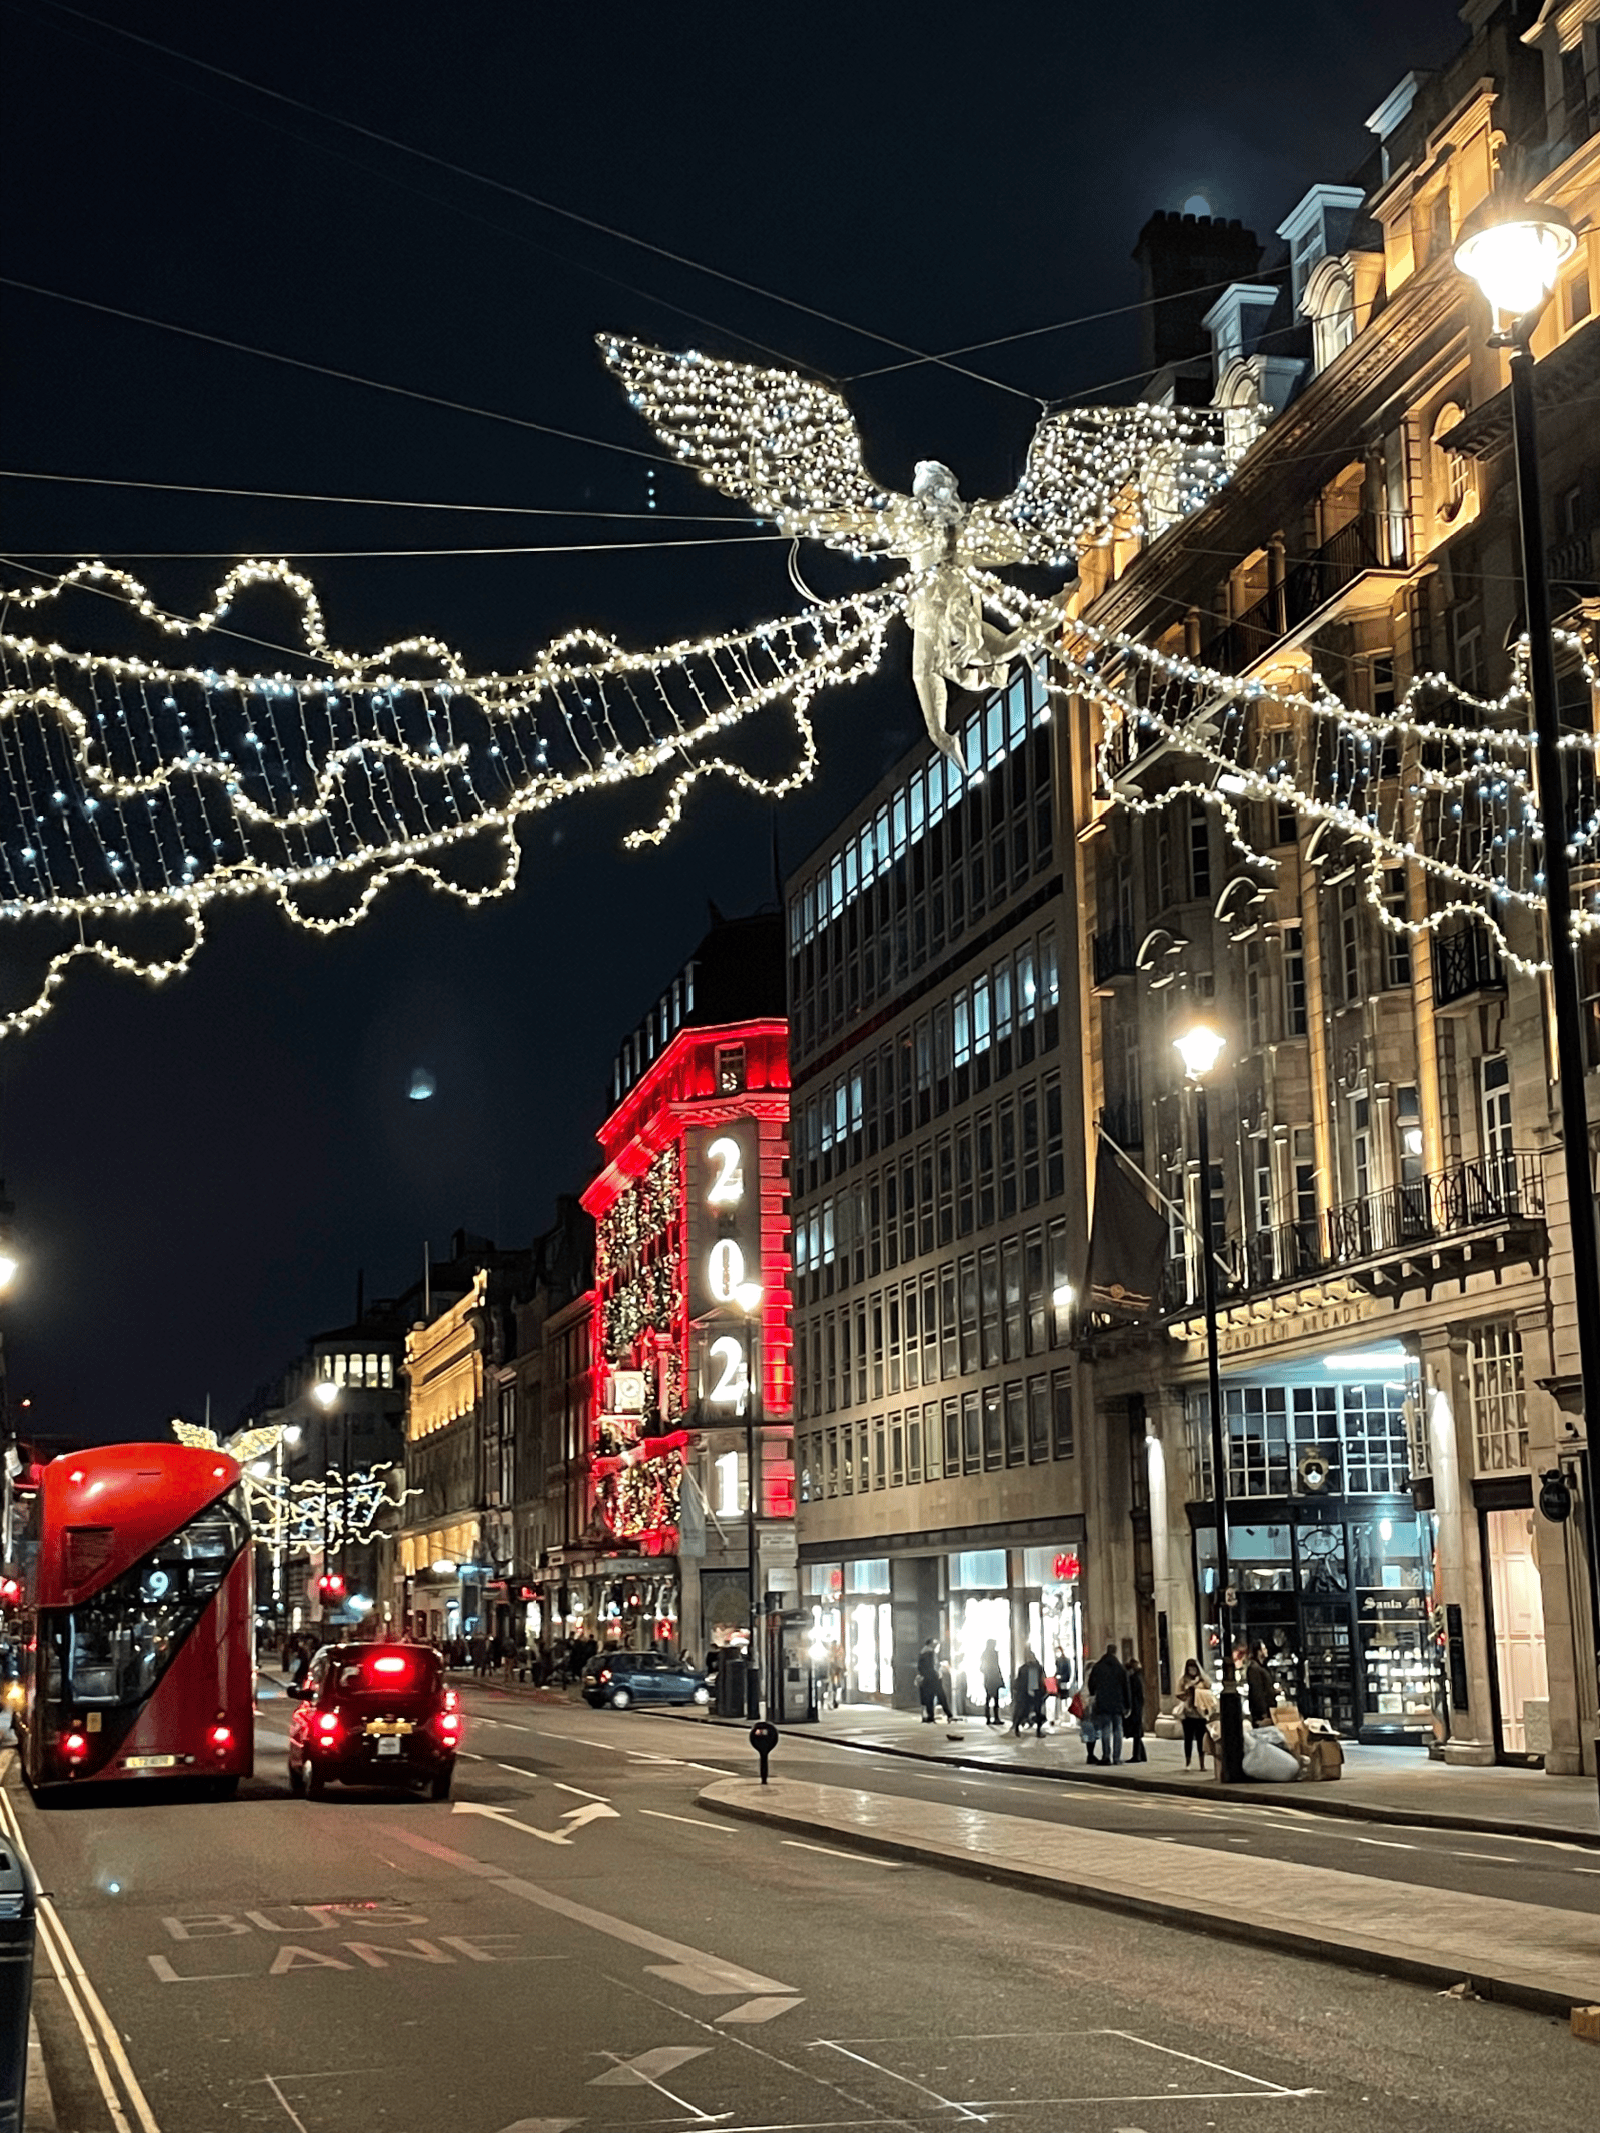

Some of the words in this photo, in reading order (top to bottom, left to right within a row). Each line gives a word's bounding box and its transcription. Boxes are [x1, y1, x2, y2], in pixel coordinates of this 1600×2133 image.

[1199, 1322, 1289, 1358] PCADILLY
[1301, 1303, 1362, 1334] ARCADE
[149, 1570, 169, 1597] 9
[1362, 1597, 1402, 1611] Santa
[162, 1902, 429, 1940] BUS
[147, 1934, 569, 1983] LANE
